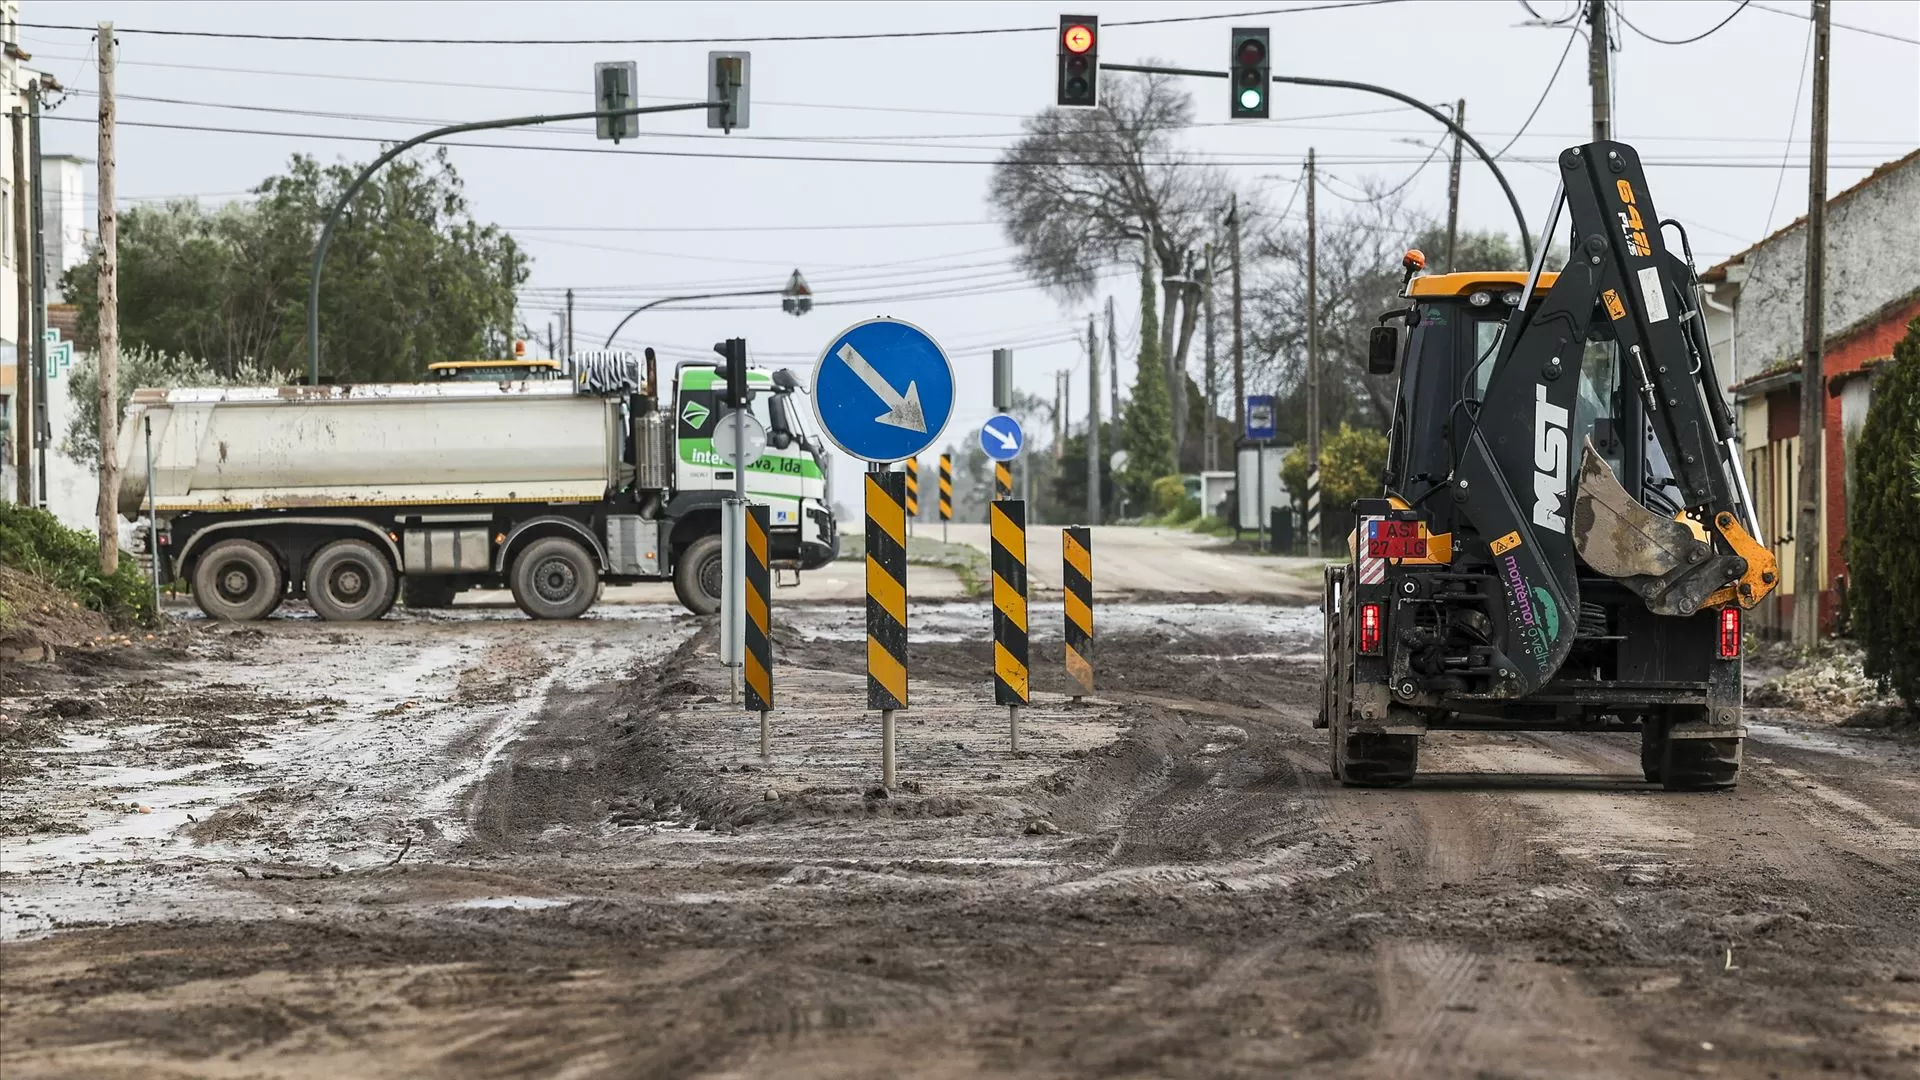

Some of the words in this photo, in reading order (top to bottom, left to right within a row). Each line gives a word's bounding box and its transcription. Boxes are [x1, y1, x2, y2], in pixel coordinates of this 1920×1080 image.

[1616, 179, 1652, 257] 642
[1533, 383, 1569, 535] MST
[1371, 541, 1390, 556] 27
[1403, 541, 1425, 556] LG
[1386, 523, 1411, 538] AS
